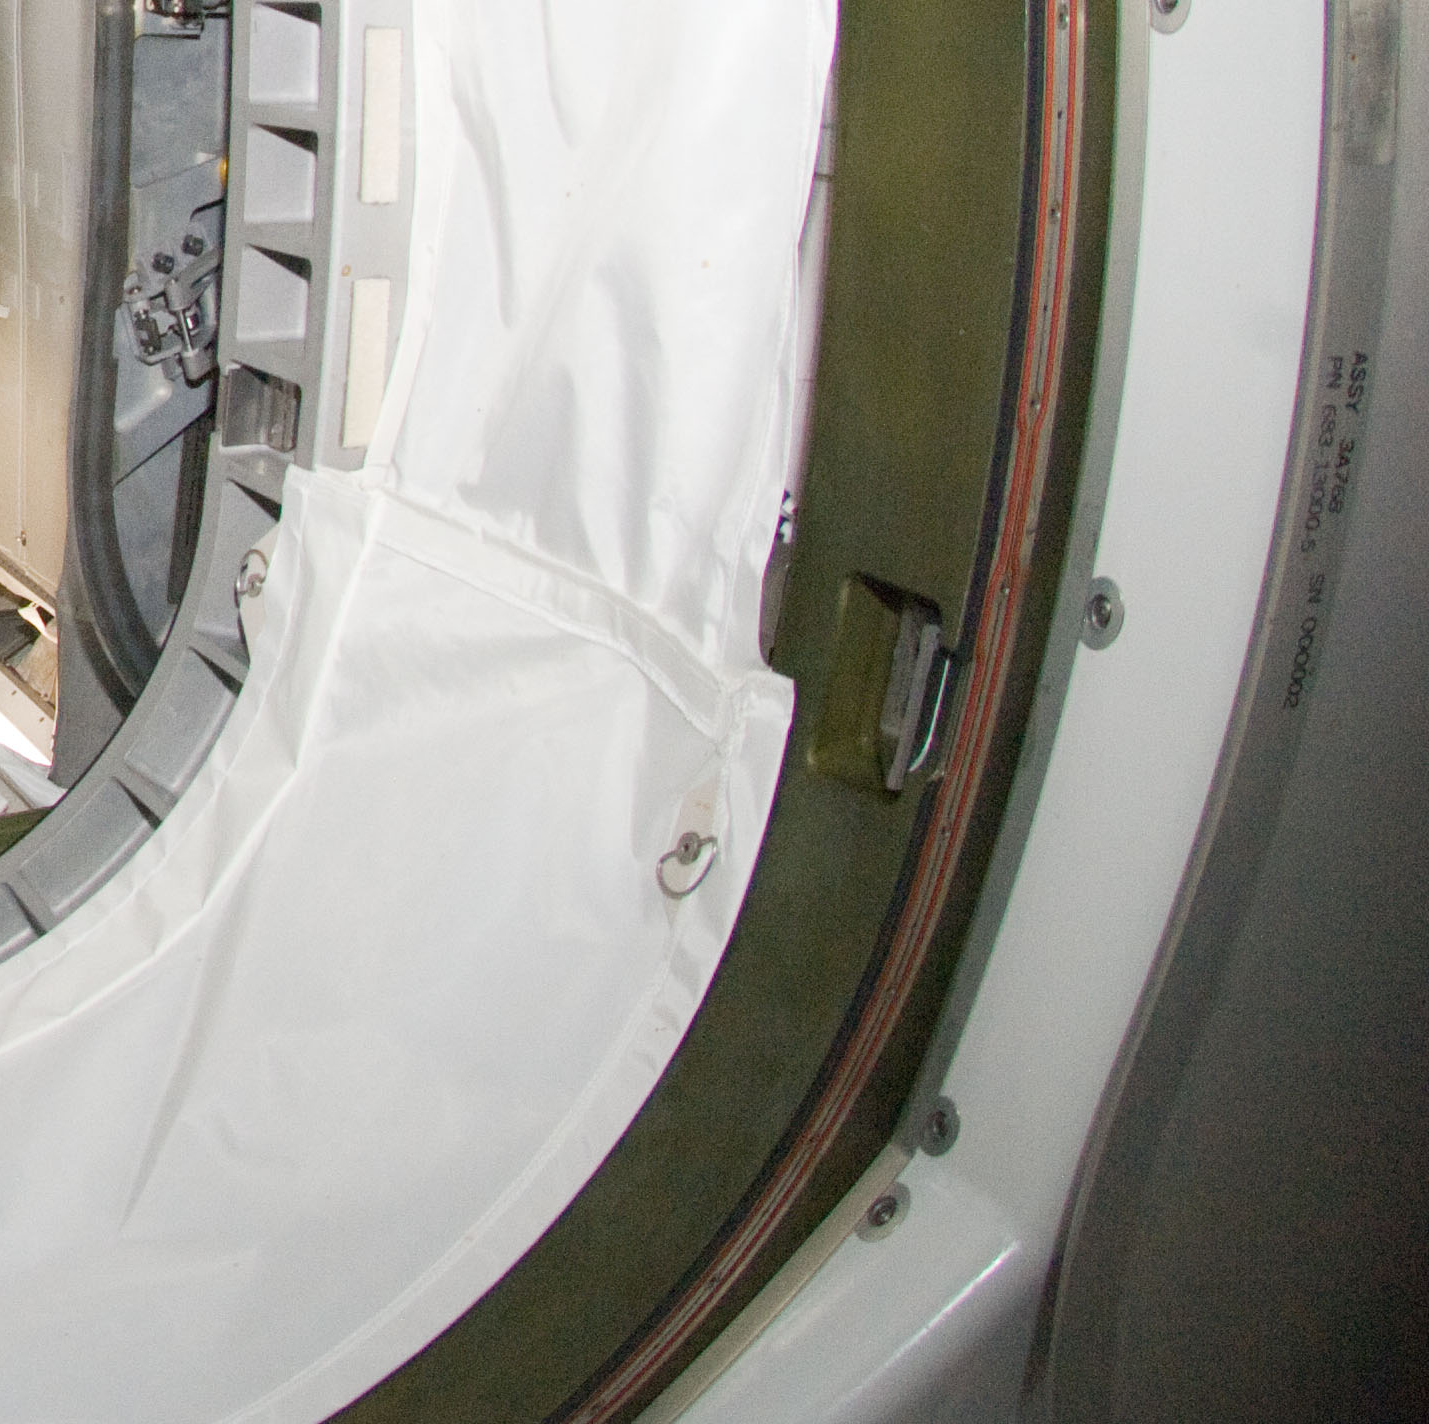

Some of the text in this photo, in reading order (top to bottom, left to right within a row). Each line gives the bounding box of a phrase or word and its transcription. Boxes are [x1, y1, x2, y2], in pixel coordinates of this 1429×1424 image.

[1326, 356, 1345, 389] PN
[1344, 351, 1369, 415] ASSY
[1307, 572, 1325, 604] SN
